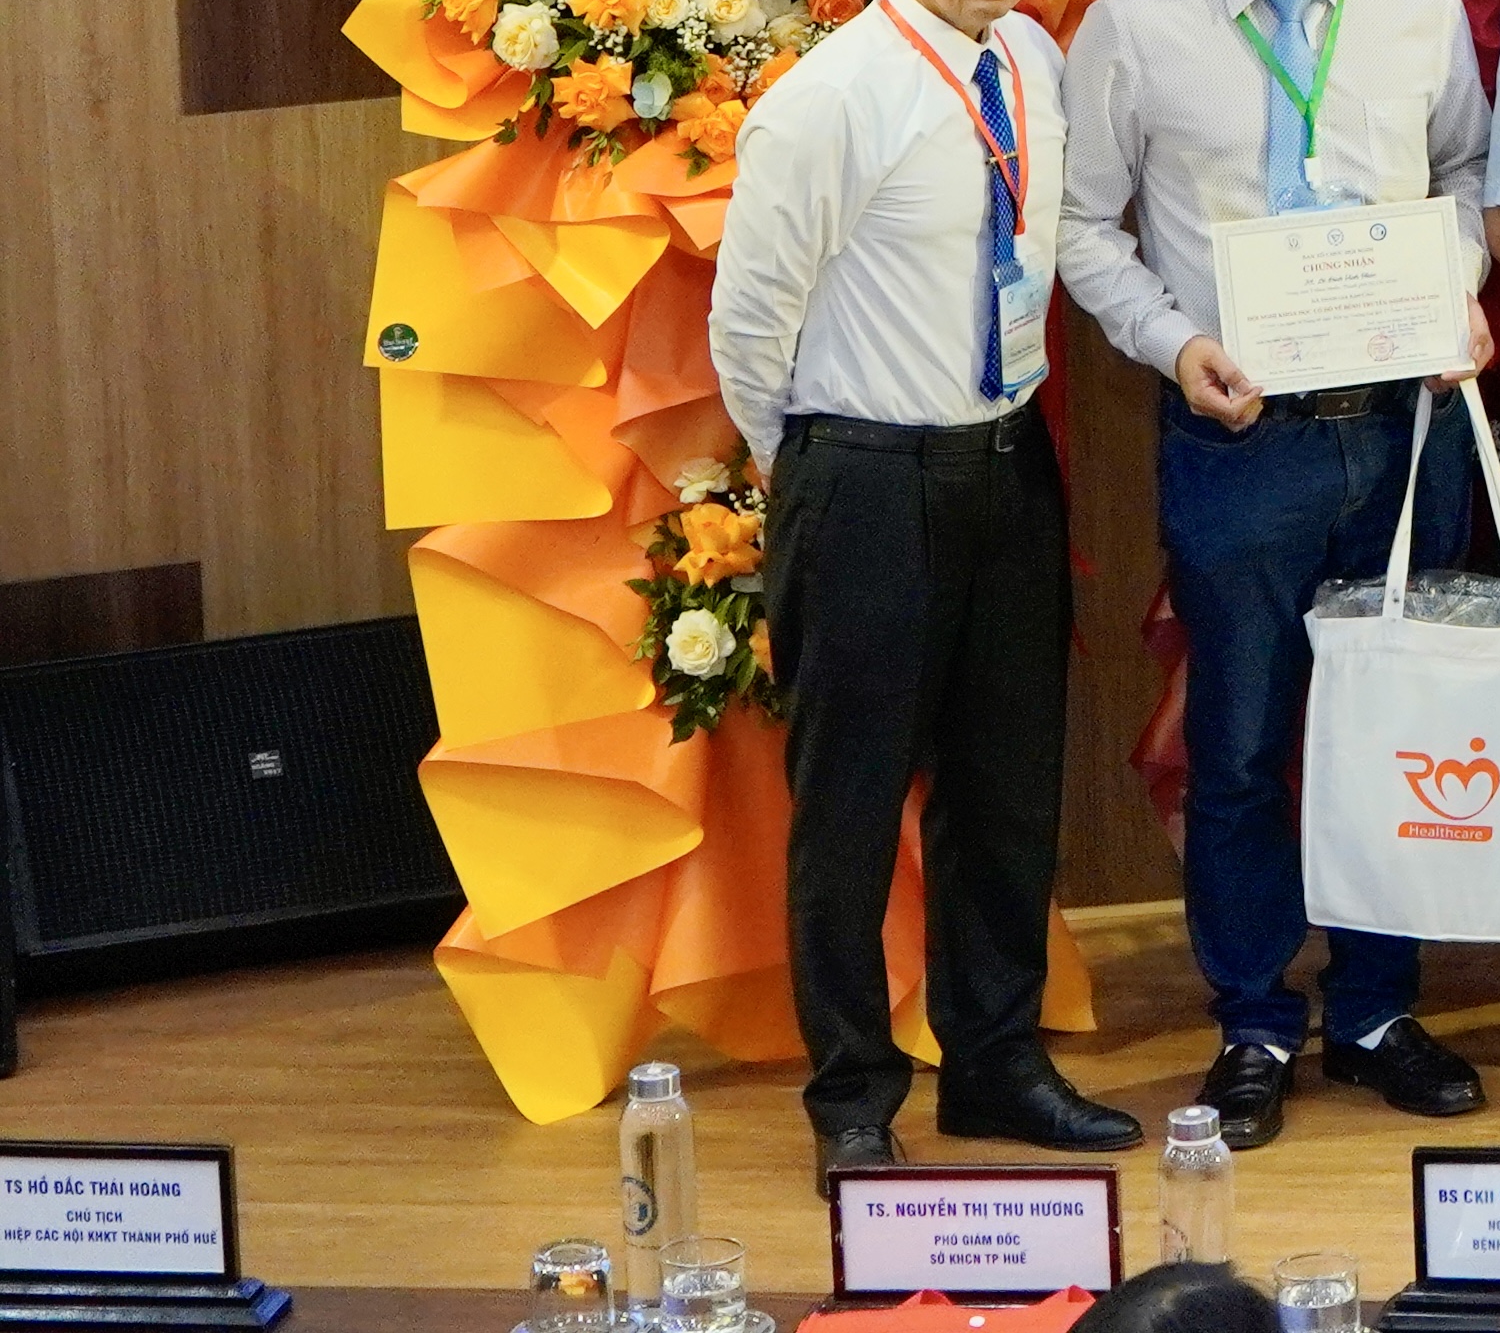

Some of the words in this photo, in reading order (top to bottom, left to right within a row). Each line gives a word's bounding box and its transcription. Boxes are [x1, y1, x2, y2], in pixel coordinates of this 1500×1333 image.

[1409, 824, 1483, 841] Healthcare
[5, 1180, 22, 1194] TS
[54, 1175, 84, 1195] ĐẮC
[89, 1179, 123, 1195] THÁI
[130, 1179, 181, 1197] HOÀNG
[1439, 1190, 1457, 1203] BS
[1464, 1190, 1494, 1204] CKII
[867, 1203, 890, 1217] TS.
[896, 1198, 957, 1217] NGUYỄN
[963, 1203, 988, 1219] THỊ
[994, 1203, 1023, 1216] THU
[1030, 1201, 1083, 1217] HƯƠNG
[96, 1211, 123, 1225] TỊCH
[934, 1233, 957, 1246] PHÓ
[963, 1234, 992, 1246] GIÁM
[997, 1232, 1020, 1246] ĐỐC
